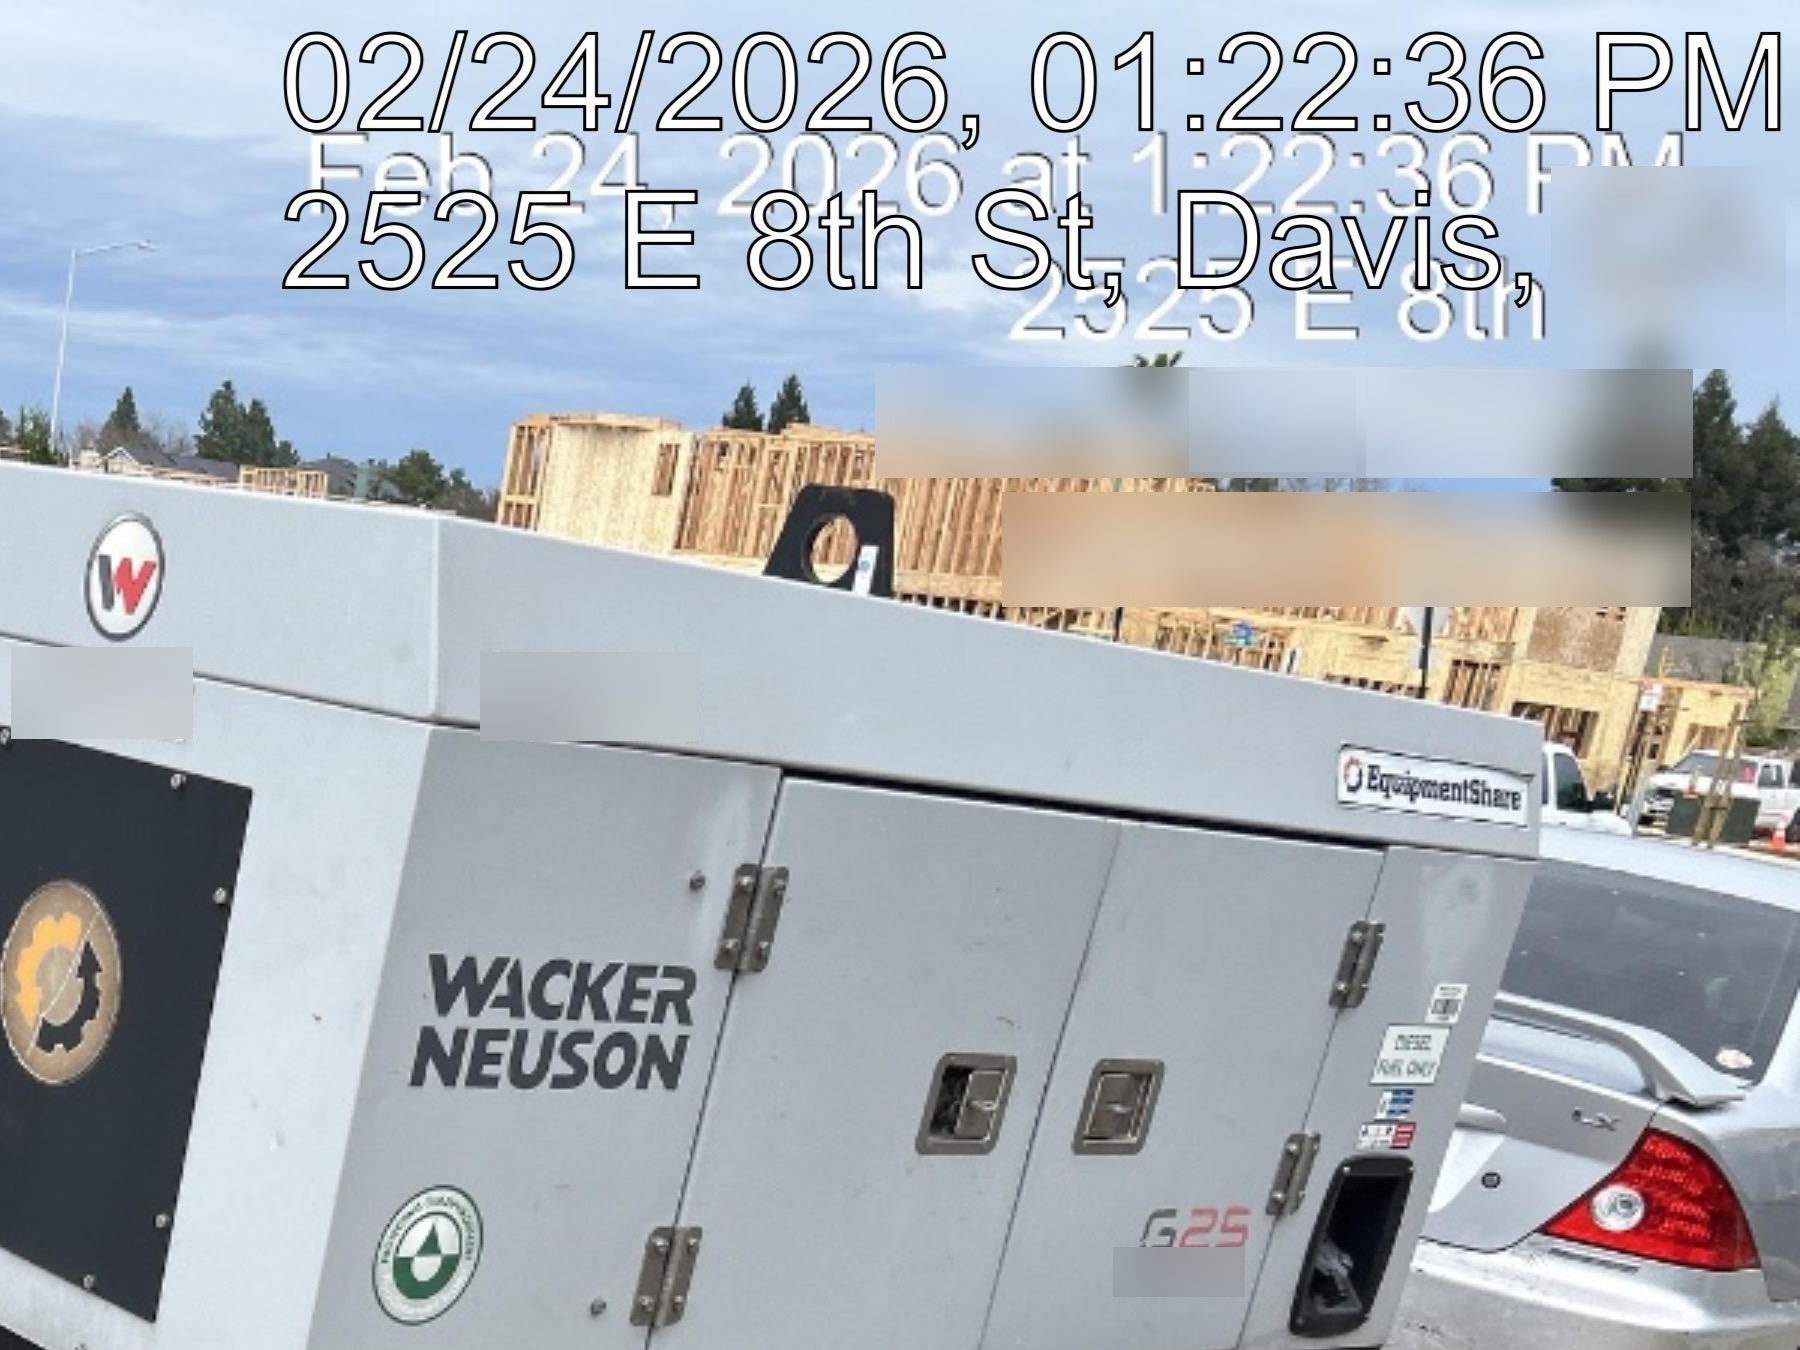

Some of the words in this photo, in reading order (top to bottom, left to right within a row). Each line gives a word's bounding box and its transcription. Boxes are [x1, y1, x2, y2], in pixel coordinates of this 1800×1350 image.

[1367, 764, 1522, 811] EquipmentShare
[428, 953, 698, 1026] WACKER
[408, 1026, 690, 1090] NEUSON
[1140, 1205, 1251, 1248] G25
